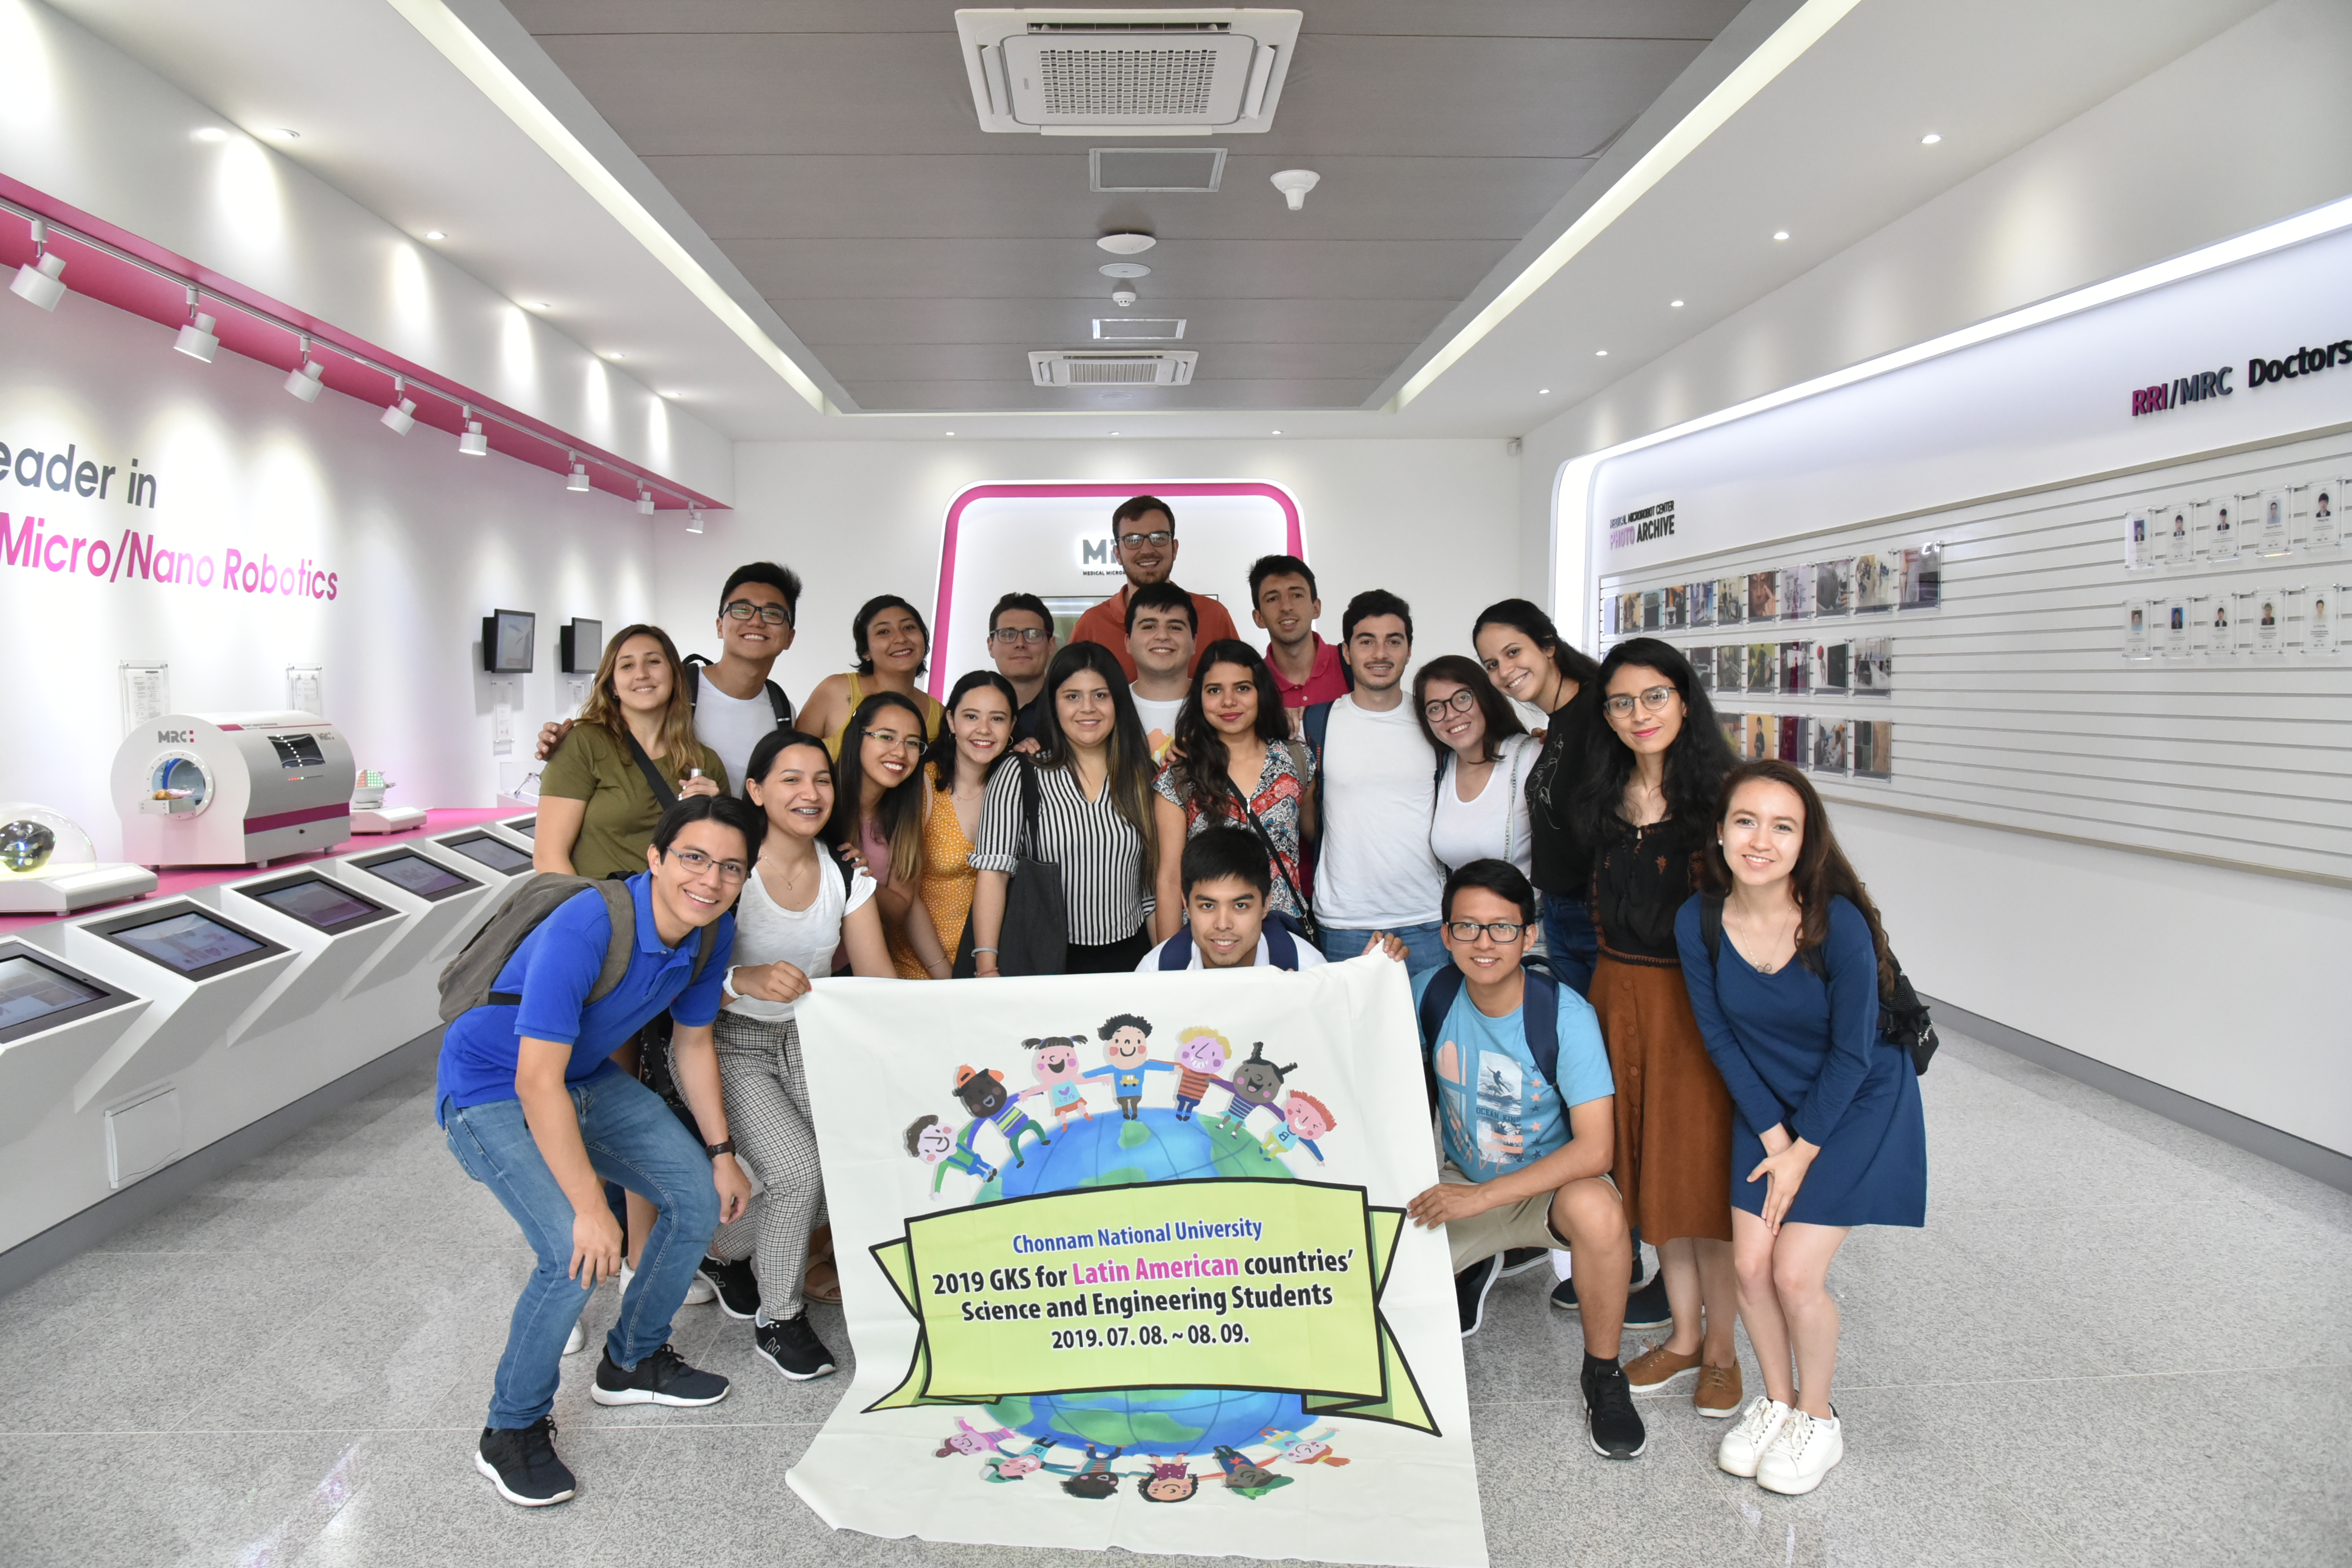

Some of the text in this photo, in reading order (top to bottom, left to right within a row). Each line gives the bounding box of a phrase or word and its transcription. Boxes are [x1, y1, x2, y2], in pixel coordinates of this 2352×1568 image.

[2132, 339, 2352, 416] RRI/MRC Doctors
[127, 458, 156, 509] in
[1656, 500, 1675, 515] CENTER
[1610, 514, 1675, 550] PHOTO ARCHIVE
[223, 548, 338, 601] Robotics
[1476, 1107, 1521, 1123] OCEAN KING
[1278, 1131, 1290, 1142] B
[1013, 1217, 1262, 1253] Chonnam National University
[932, 1248, 1353, 1294] 2019 GKS for Latin American countries’
[961, 1283, 1333, 1321] Science and Engineering Students
